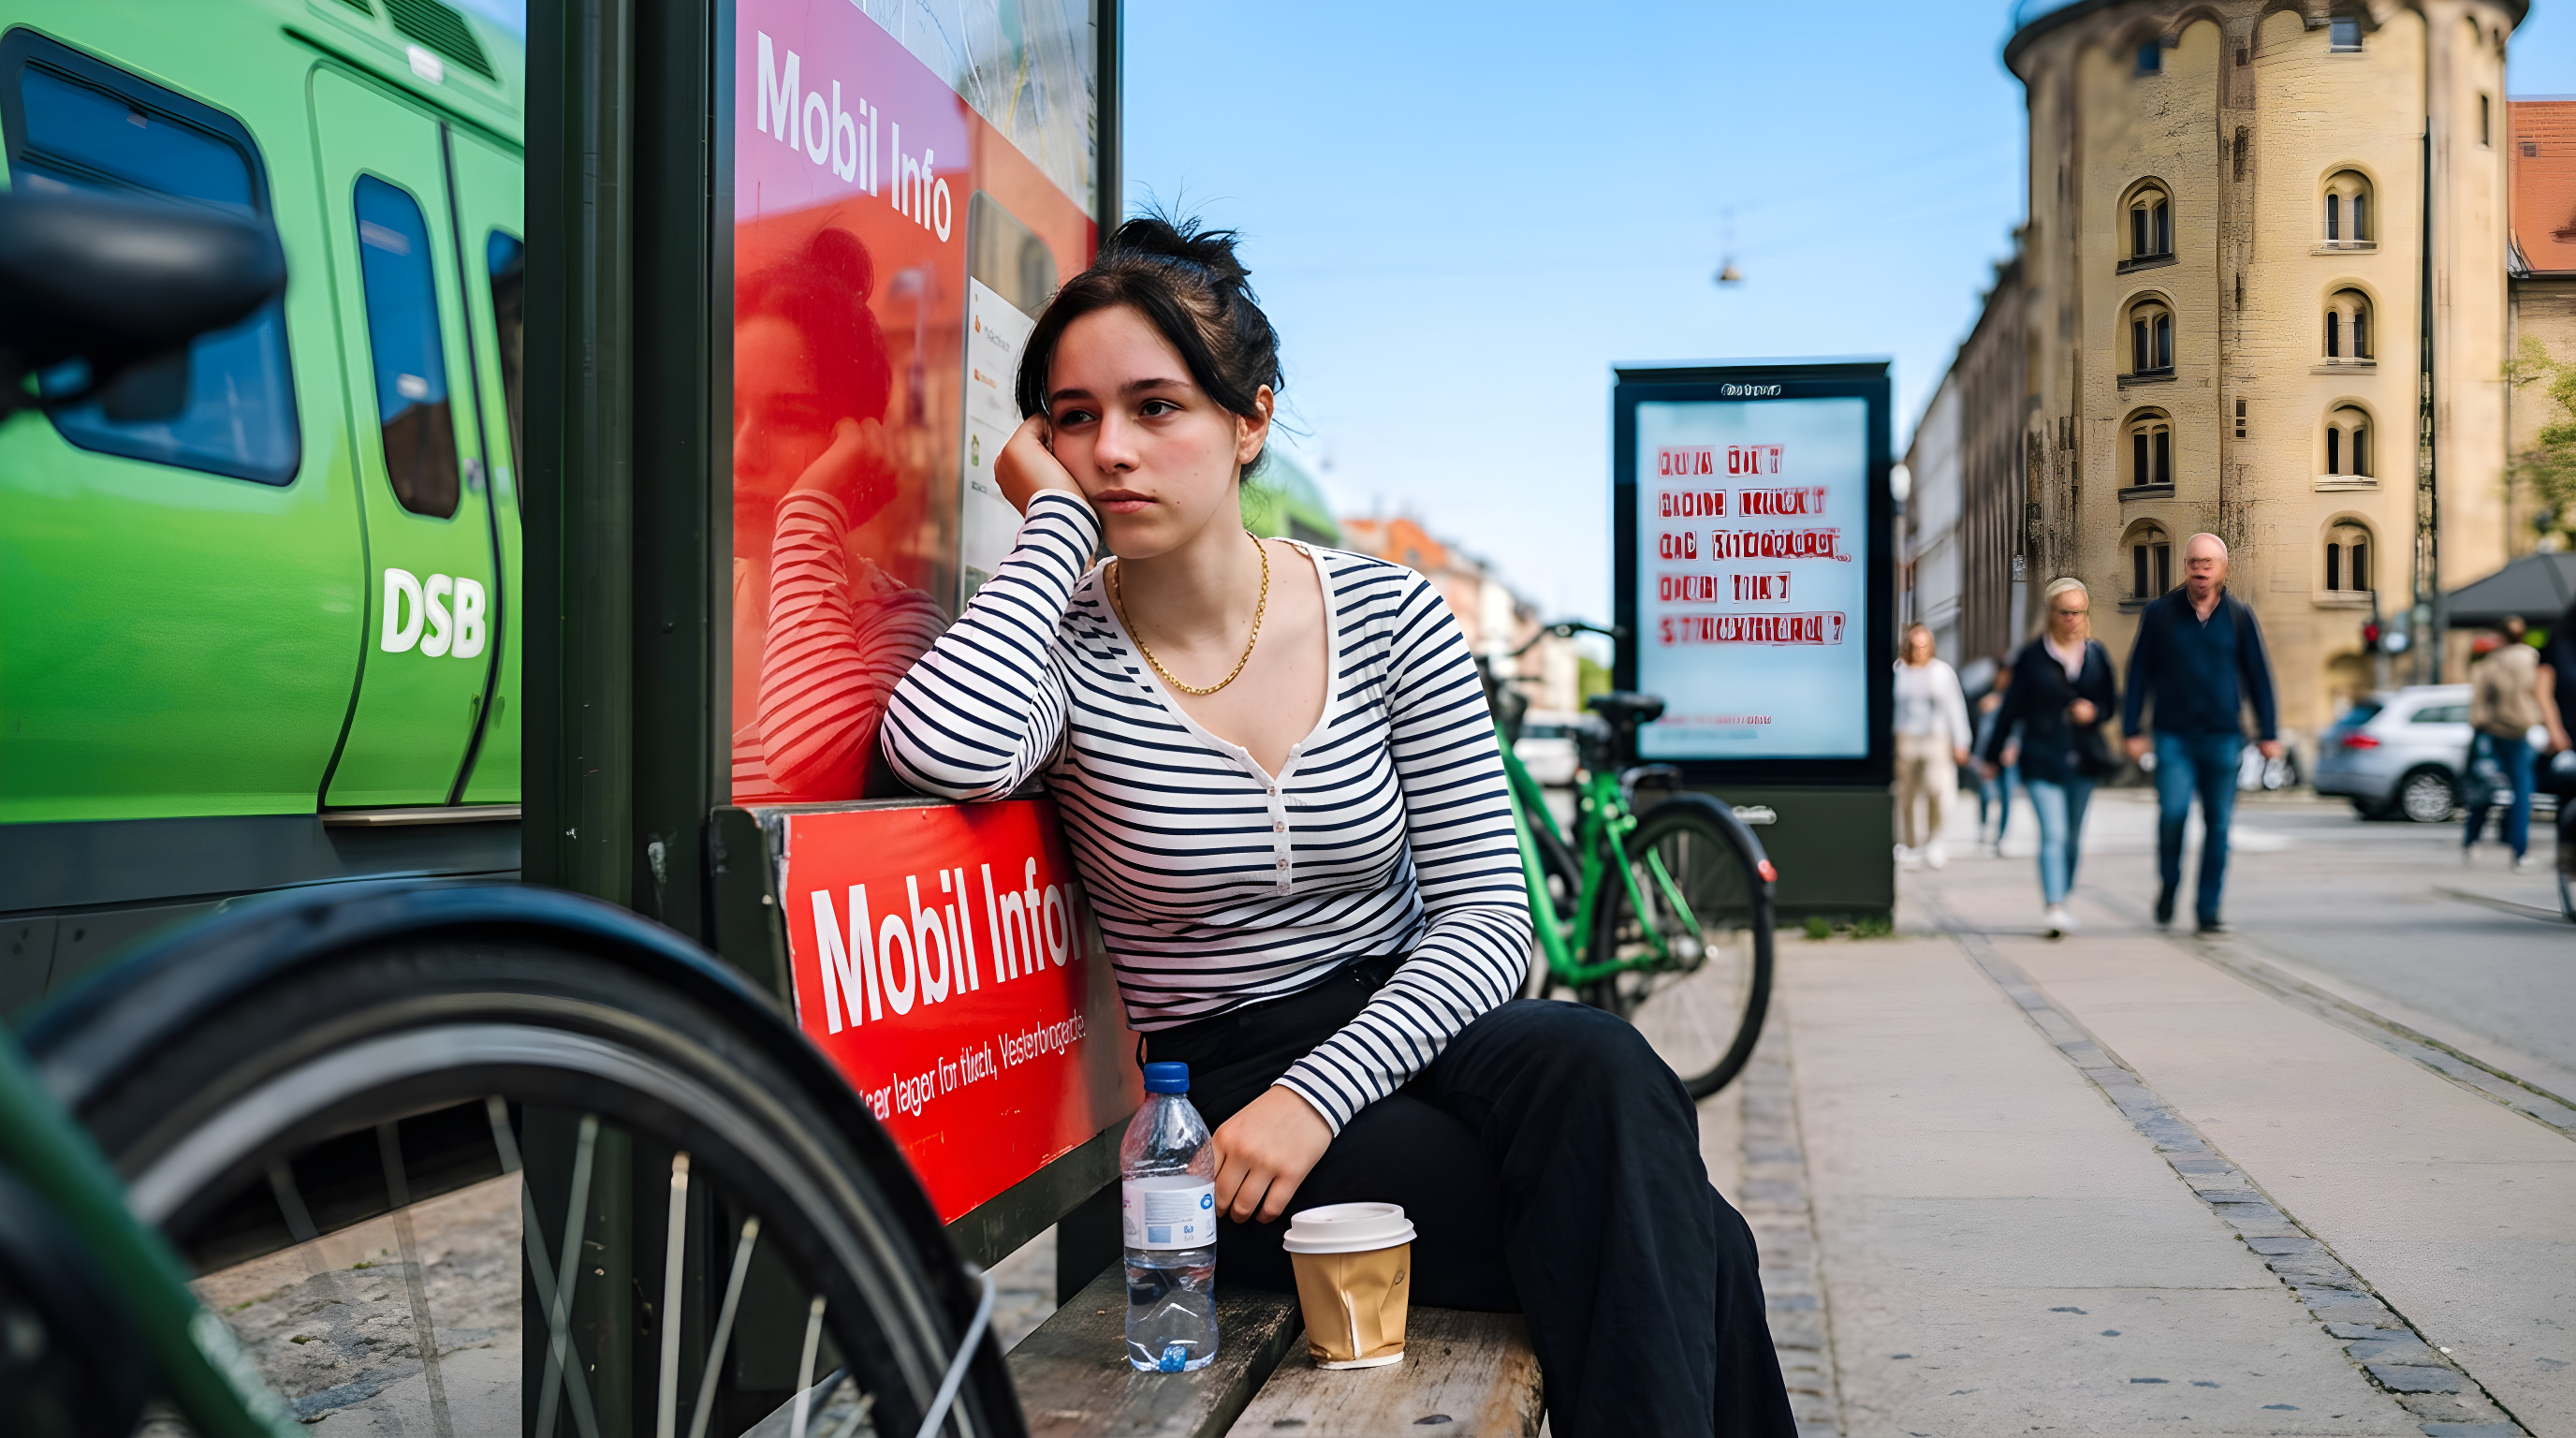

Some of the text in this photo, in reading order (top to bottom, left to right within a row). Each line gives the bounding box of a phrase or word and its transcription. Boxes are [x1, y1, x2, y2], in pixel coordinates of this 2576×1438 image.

[757, 30, 952, 242] Mobil Info
[381, 567, 486, 658] DSB
[811, 867, 979, 1035] Mobil
